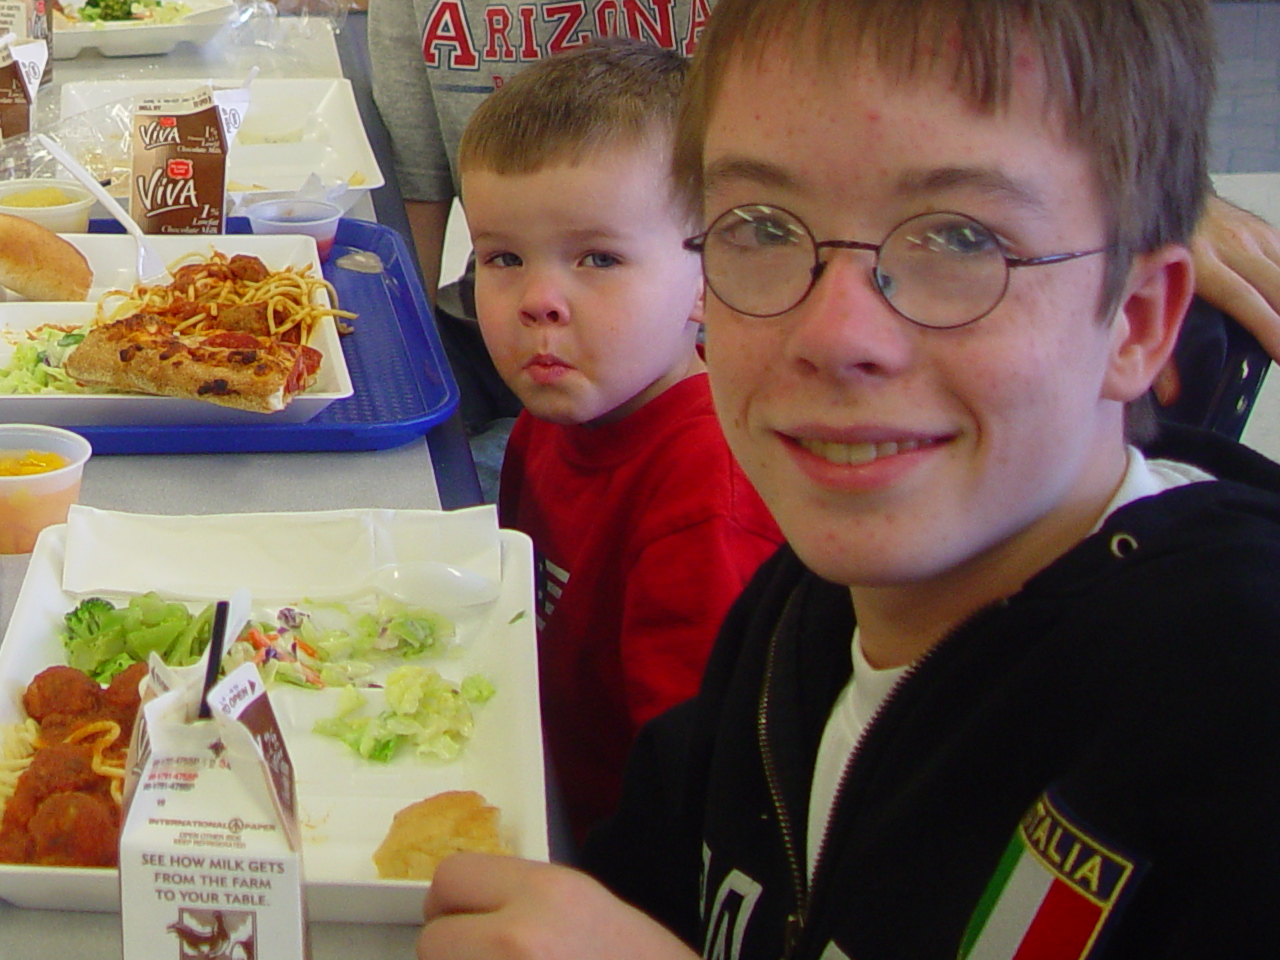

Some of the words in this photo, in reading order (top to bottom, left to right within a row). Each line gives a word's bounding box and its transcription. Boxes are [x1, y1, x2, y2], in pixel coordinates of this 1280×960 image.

[142, 853, 166, 866] SEE
[170, 855, 205, 869] HOW
[209, 859, 244, 872] MILK
[248, 861, 285, 874] GETS
[154, 872, 195, 885] FROM
[200, 875, 227, 887] THE
[232, 877, 272, 889] FARM
[155, 889, 175, 901] TO
[180, 890, 219, 904] YOUR
